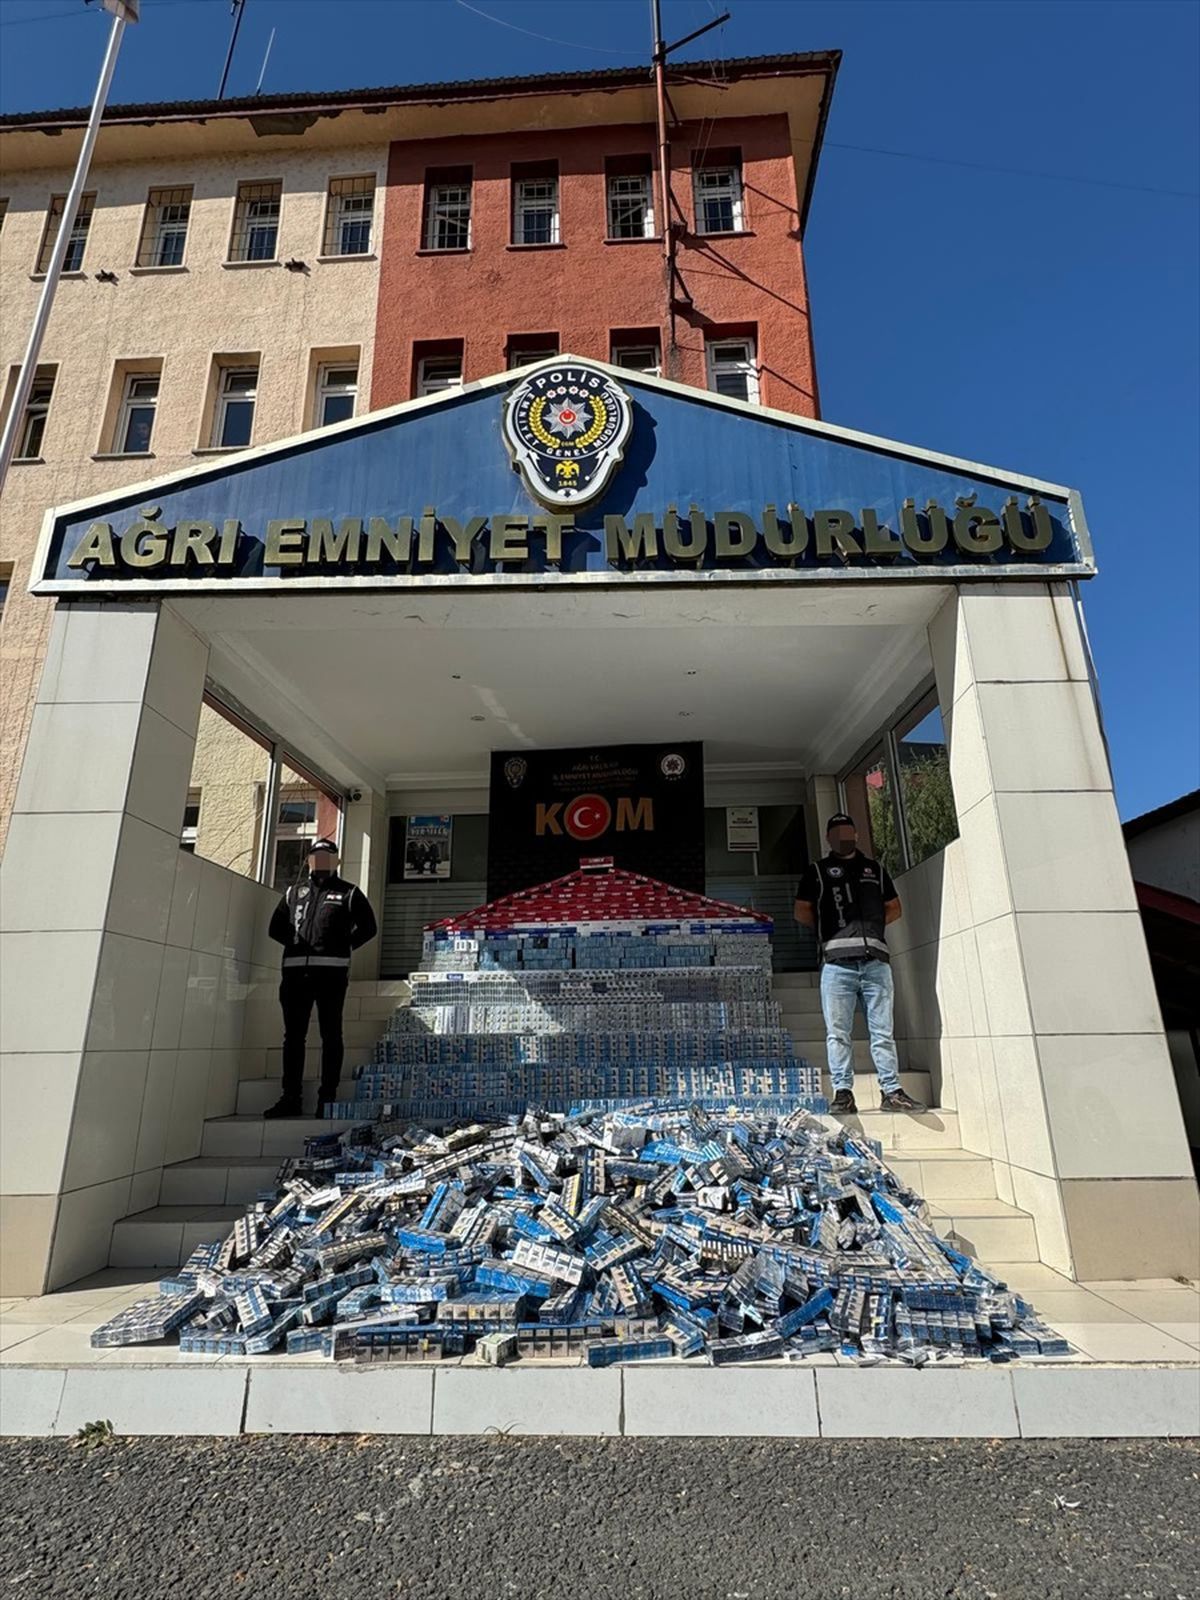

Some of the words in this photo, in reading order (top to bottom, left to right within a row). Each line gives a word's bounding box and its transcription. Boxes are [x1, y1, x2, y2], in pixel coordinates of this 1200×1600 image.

[536, 371, 600, 389] POLİS
[546, 447, 589, 457] GENEL
[66, 506, 241, 571] AĞRI
[263, 506, 575, 568] EMNİYET
[604, 492, 1054, 563] MÜDÜRLÜĞÜ
